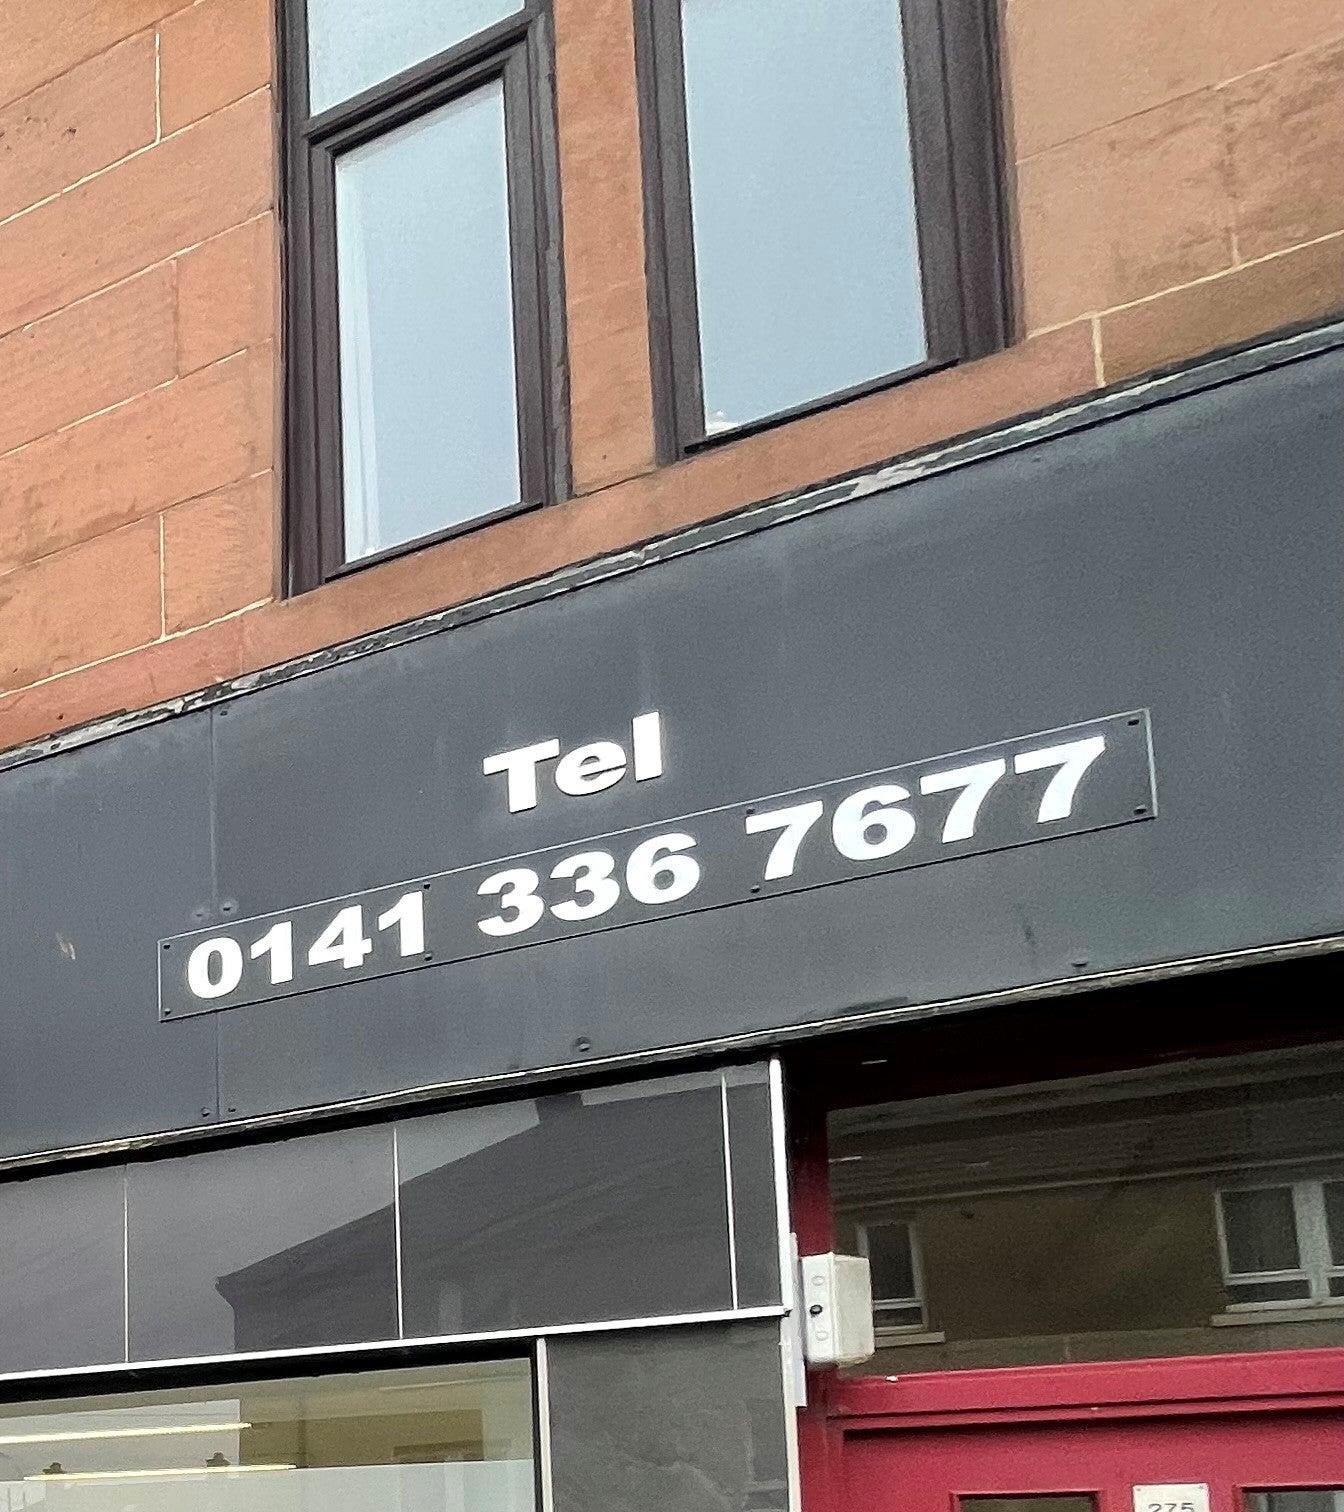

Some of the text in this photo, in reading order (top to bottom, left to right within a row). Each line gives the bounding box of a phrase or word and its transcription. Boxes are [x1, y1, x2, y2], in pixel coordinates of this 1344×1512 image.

[483, 712, 663, 813] Tel
[187, 735, 1107, 999] 0141 336 7677
